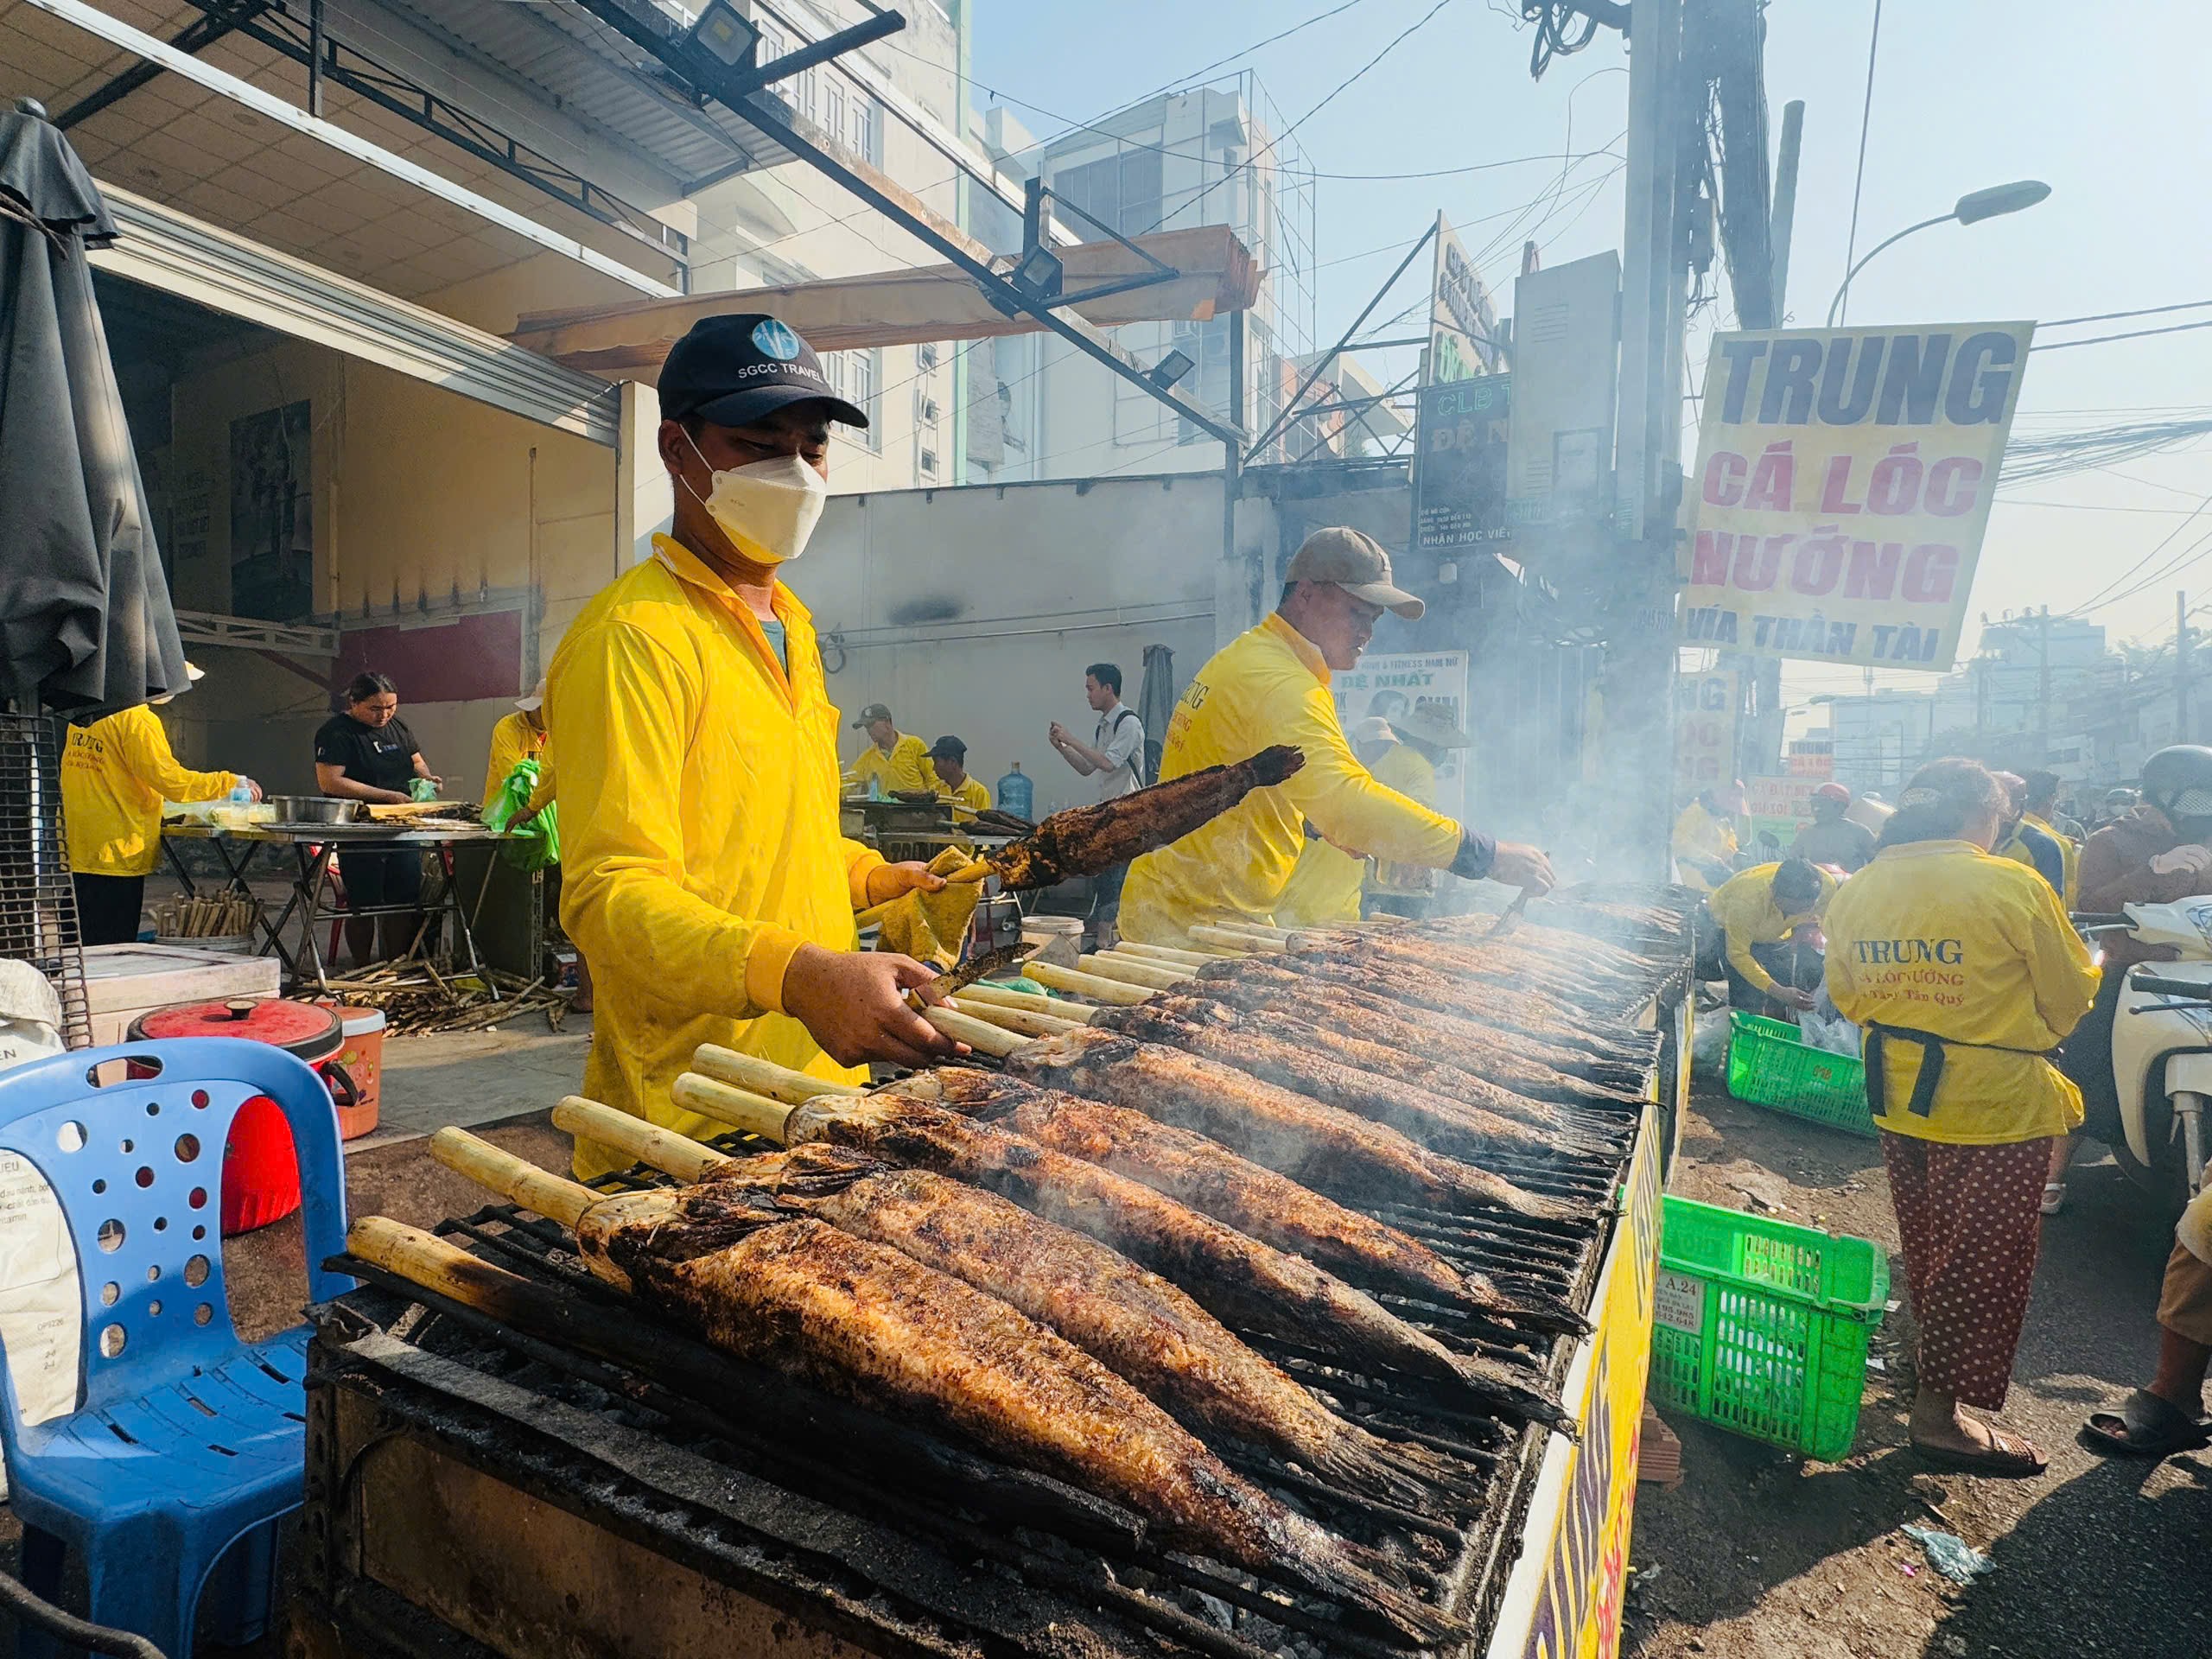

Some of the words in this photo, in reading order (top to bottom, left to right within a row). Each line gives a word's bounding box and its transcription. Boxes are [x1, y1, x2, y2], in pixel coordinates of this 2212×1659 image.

[738, 363, 778, 379] SGCC
[779, 363, 823, 384] TRAVEL
[1721, 331, 2018, 426] TRUNG
[1437, 387, 1493, 416] CLB
[1702, 440, 1793, 512] CÁ
[1821, 442, 1984, 518] LÓC
[1423, 533, 1454, 547] NHẬN
[1459, 530, 1483, 543] HỌC
[1690, 524, 1961, 603] NƯỚNG
[1390, 659, 1423, 670] FITNESS
[1852, 938, 1964, 965] TRUNG
[1907, 969, 1965, 987] ƯỚNG
[1666, 1277, 1696, 1296] A.24
